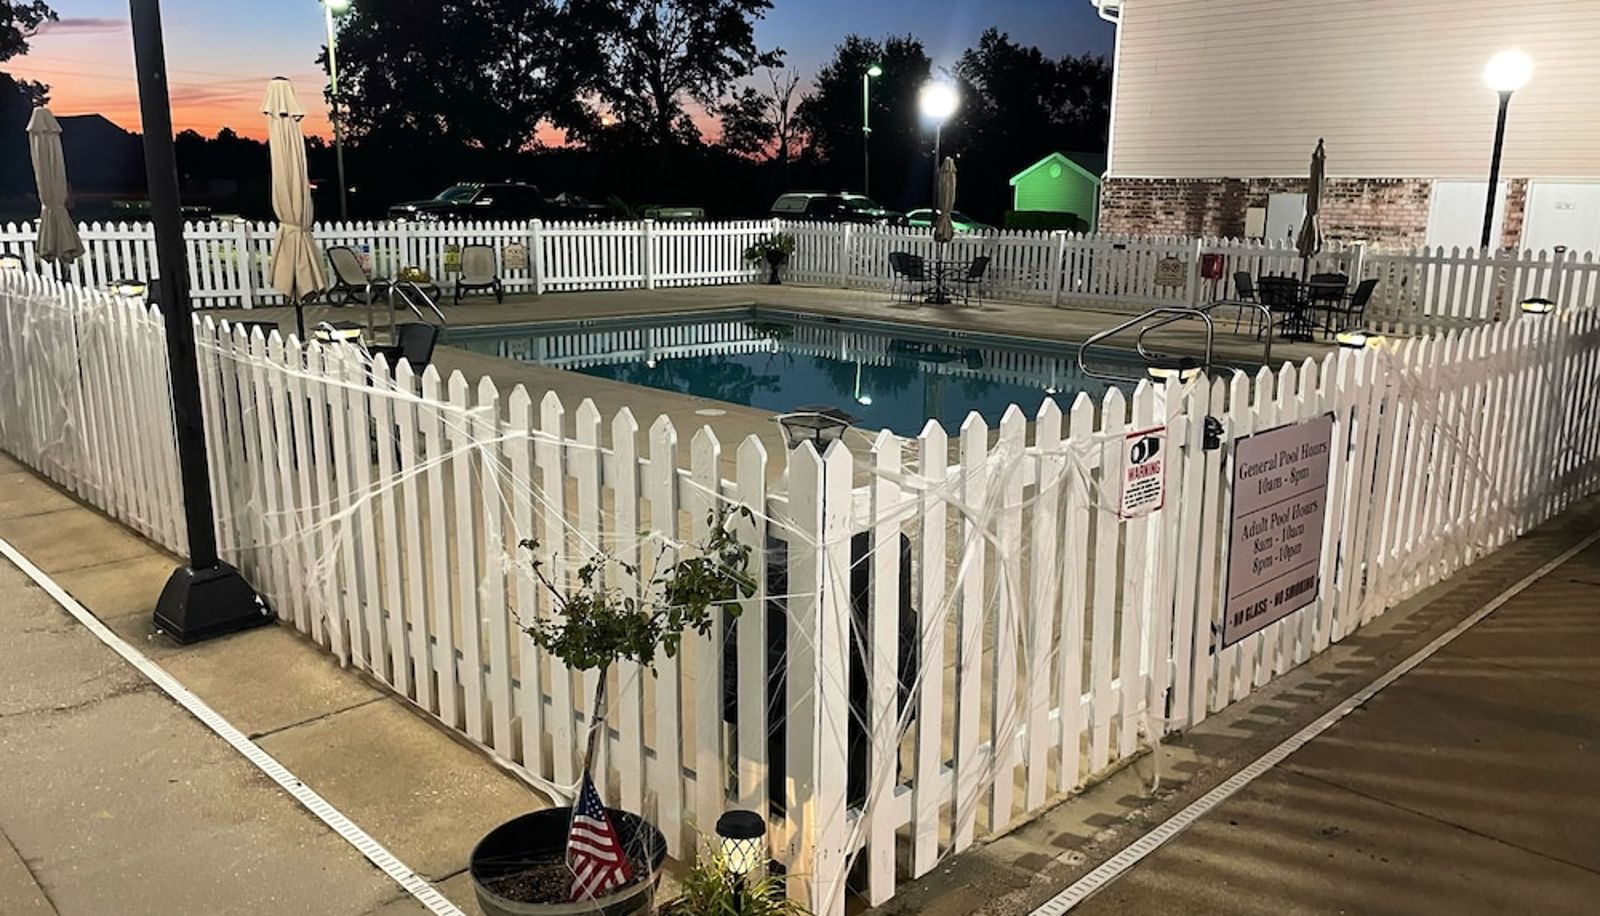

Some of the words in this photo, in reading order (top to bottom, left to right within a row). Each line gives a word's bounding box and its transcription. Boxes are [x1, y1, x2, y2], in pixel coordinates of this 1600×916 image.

[1239, 453, 1277, 480] General
[1279, 446, 1300, 467] Pool
[1301, 441, 1328, 460] Hours
[1258, 476, 1283, 495] 10am
[1289, 467, 1310, 486] 8pm
[1241, 516, 1268, 542] Adult
[1269, 508, 1290, 531] Pool
[1292, 500, 1318, 521] Hours
[1253, 536, 1273, 555] 8am
[1282, 523, 1305, 543] 10am
[1252, 556, 1273, 576] 8pm
[1279, 542, 1302, 562] 10pm
[1233, 608, 1245, 628] NO
[1245, 597, 1268, 622] GLASS
[1274, 589, 1284, 607] NO
[1285, 575, 1315, 600] SMOKING
